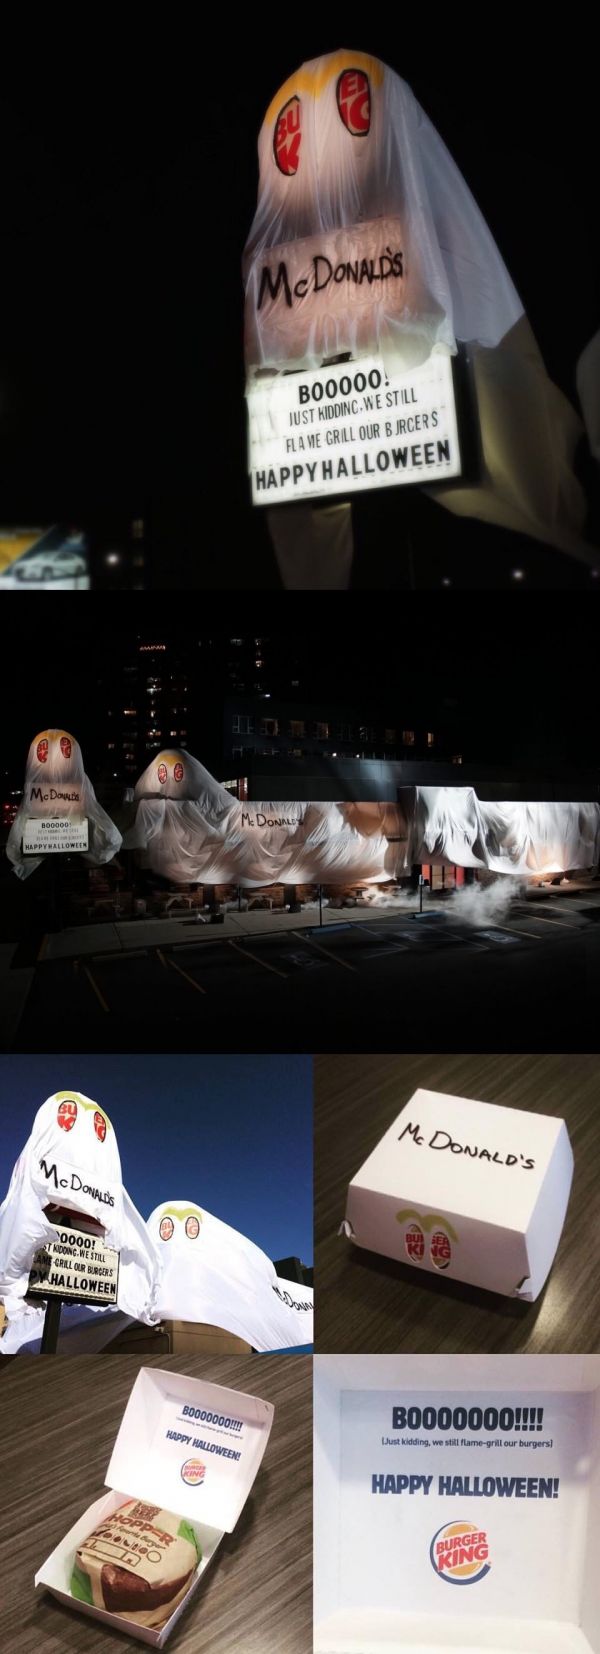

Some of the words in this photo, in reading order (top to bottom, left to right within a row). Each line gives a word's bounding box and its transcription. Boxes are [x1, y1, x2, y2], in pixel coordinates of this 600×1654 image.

[298, 369, 389, 404] BOOOOO!
[289, 408, 315, 426] JUST
[363, 394, 382, 411] WE
[385, 387, 418, 407] STILL
[325, 426, 356, 445] GRILL
[359, 422, 381, 441] OUR
[256, 461, 318, 490] HAPPY
[321, 439, 451, 481] HALLOWEEN
[43, 1242, 52, 1252] ST
[79, 1249, 89, 1259] WE
[90, 1253, 106, 1263] STILL
[56, 1230, 96, 1250] OOOO!
[74, 1263, 86, 1273] OUR
[87, 1266, 114, 1278] BURGERS
[51, 1273, 116, 1294] HALLOWEEN
[182, 1405, 243, 1432] BOOOOOOO!!!!
[392, 1406, 544, 1431] BOOOOOOO!!!!
[166, 1430, 192, 1445] HAPPY
[192, 1438, 241, 1461] HALLOWEEN!
[401, 1438, 431, 1447] kidding,
[460, 1439, 502, 1448] flame-grill
[371, 1474, 433, 1495] HAPPY
[438, 1475, 560, 1499] HALLOWEEN!
[104, 1513, 173, 1547] HOPPER
[436, 1532, 487, 1554] BURGER
[438, 1543, 489, 1571] KING
